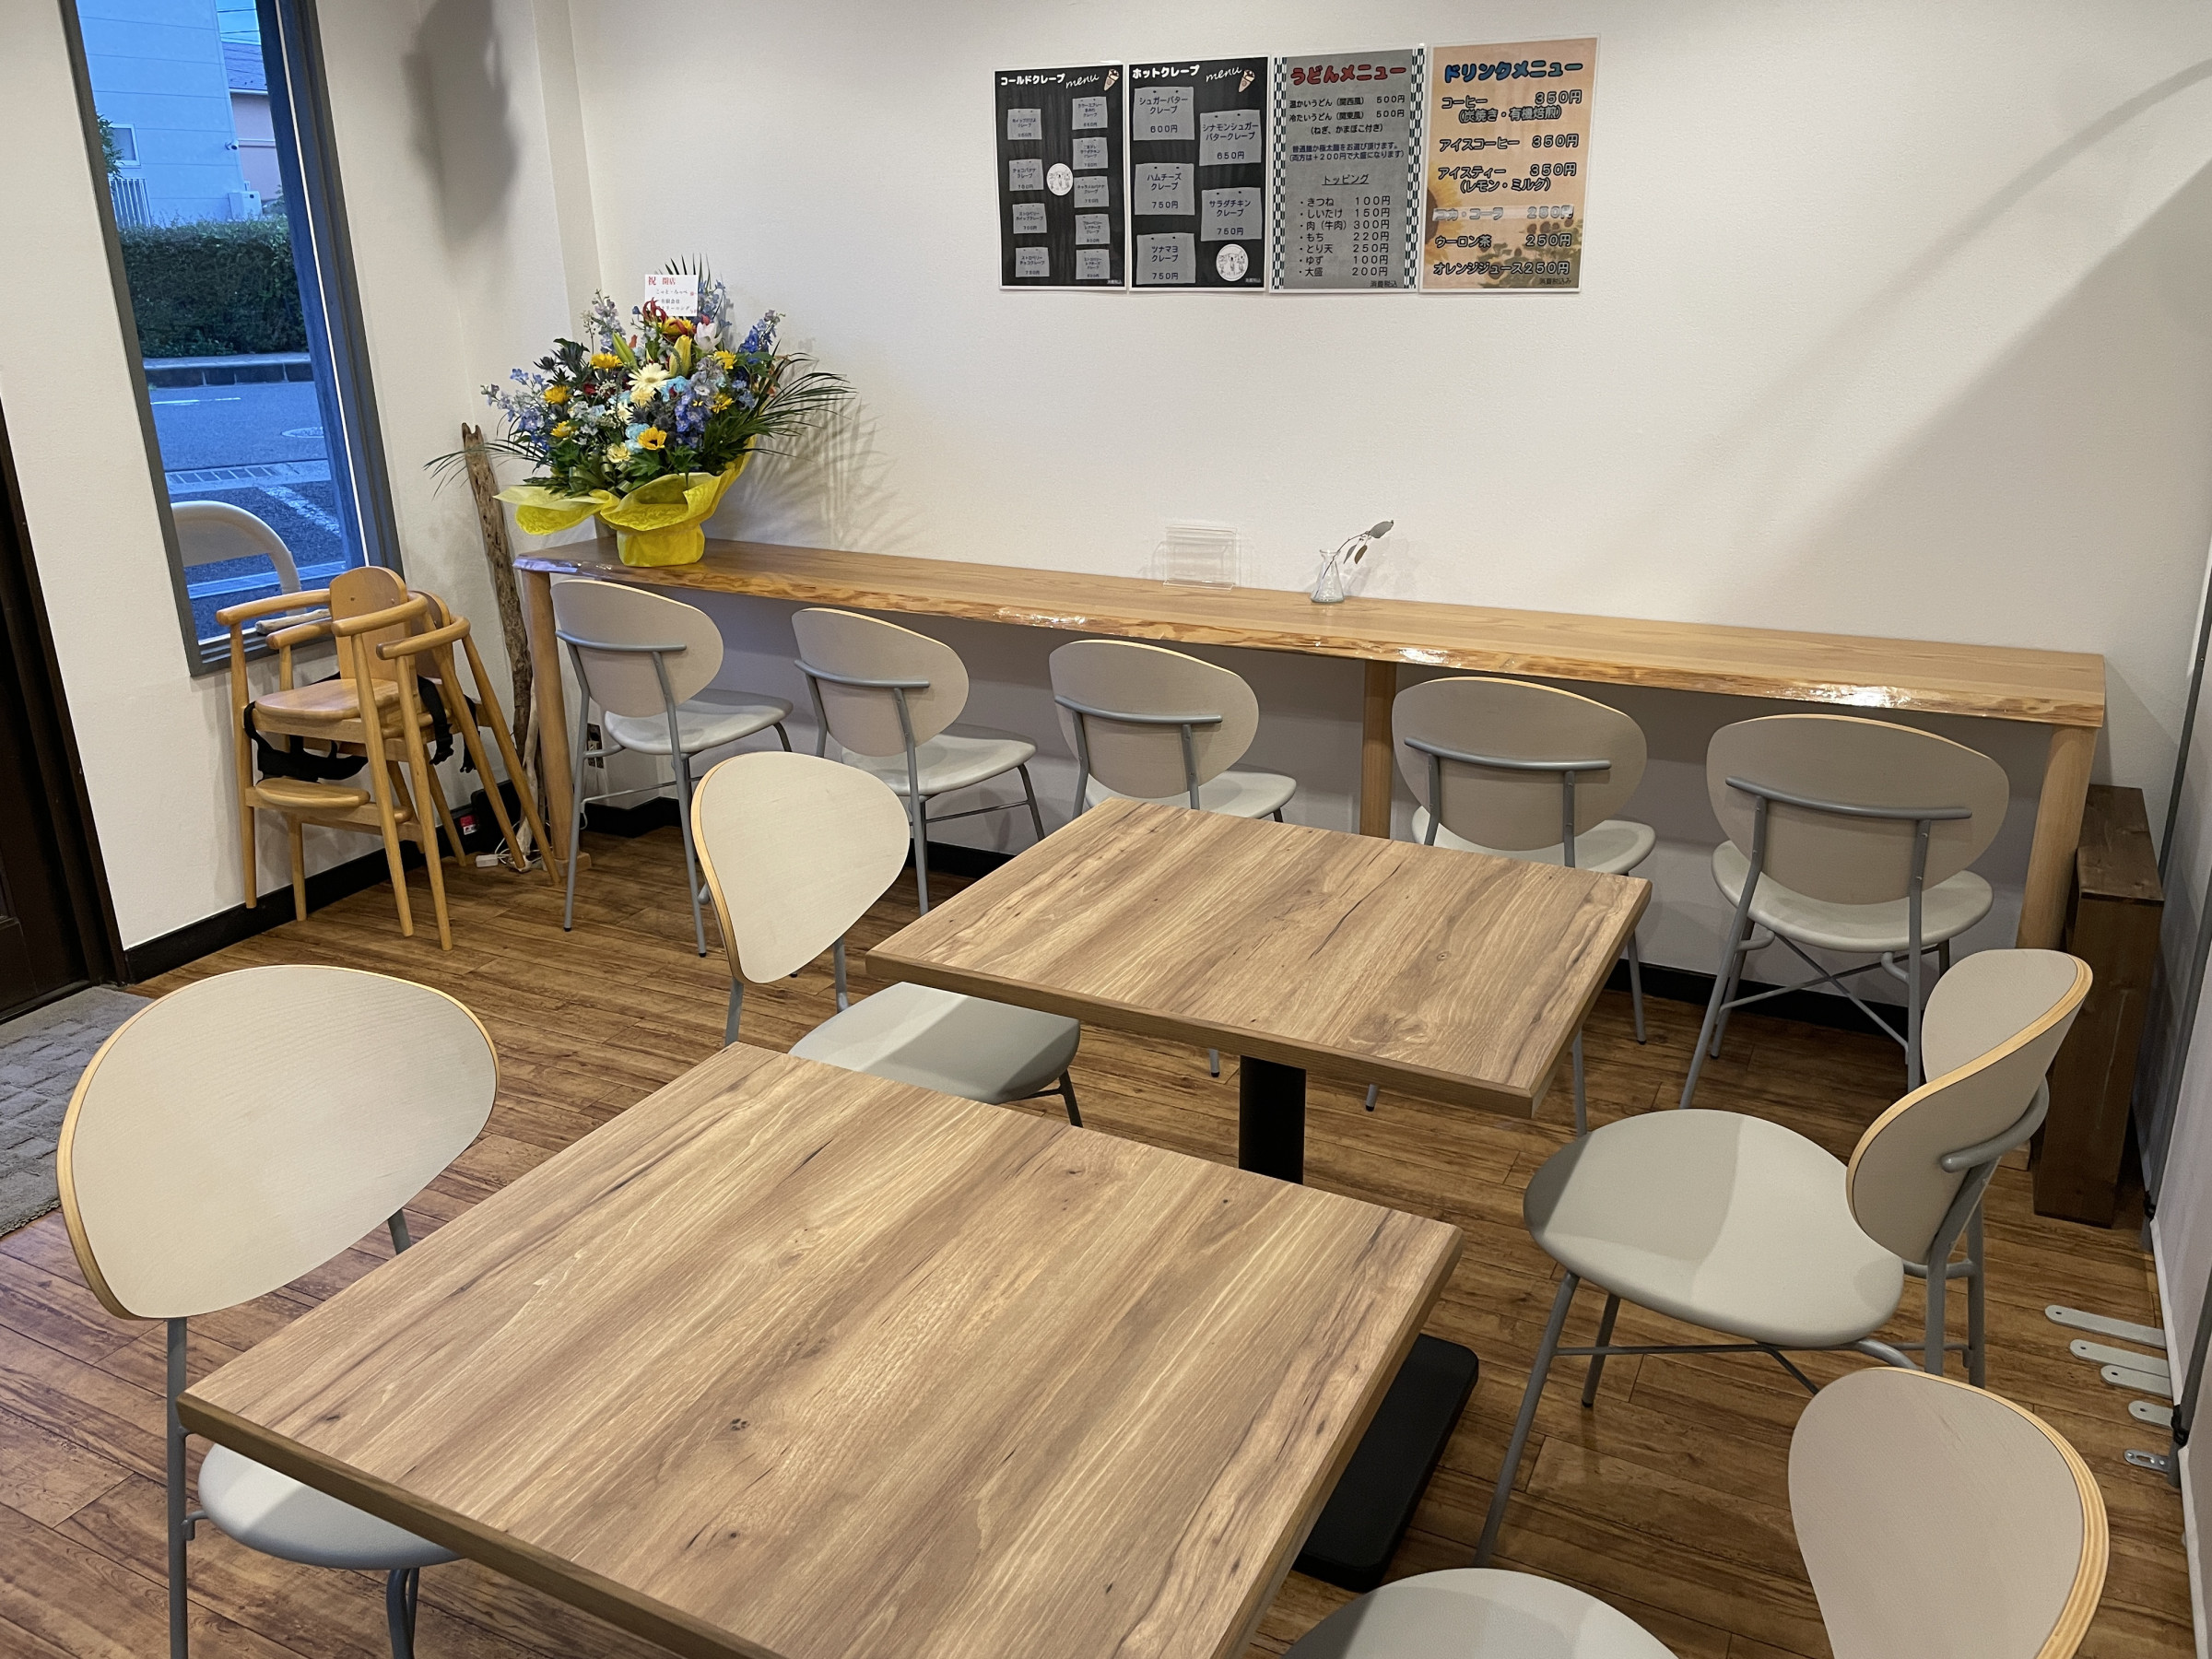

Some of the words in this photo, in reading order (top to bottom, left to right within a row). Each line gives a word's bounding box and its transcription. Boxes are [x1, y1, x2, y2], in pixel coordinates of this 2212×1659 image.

[1132, 65, 1200, 79] ホットクレープ
[1206, 66, 1242, 83] menu
[1290, 64, 1406, 86] うどんメニュー
[1444, 60, 1583, 83] ドリンクメニュー
[1000, 73, 1065, 86] コールドクレープ
[1065, 74, 1100, 89] menu
[1139, 96, 1188, 105] シュガーバター
[1376, 94, 1406, 104] 500円
[1441, 95, 1488, 109] コーヒー
[1535, 89, 1583, 104] 350円
[1149, 106, 1178, 114] クレープ
[1376, 109, 1405, 118] 500円
[1459, 105, 1562, 124] （炭焼き・有機焙煎）
[1150, 124, 1178, 133] 600円
[1203, 122, 1259, 132] シナモンシュガー
[1206, 132, 1255, 141] バタークレープ
[1440, 136, 1520, 152] アイスコーヒー
[1532, 134, 1579, 148] 350円
[1217, 151, 1245, 159] 650円
[1438, 166, 1507, 180] アイスティー
[1530, 162, 1577, 177] 350円
[1147, 173, 1182, 182] ハムチーズ
[1324, 173, 1370, 184] トッピング
[1150, 182, 1179, 191] クレープ
[1460, 177, 1550, 194] （レモン・ミルク）
[1151, 200, 1179, 209] 750円
[1209, 199, 1252, 207] サラダチキン
[1355, 195, 1391, 206] 100円
[1217, 208, 1244, 217] クレープ
[1355, 207, 1390, 218] 150円
[1353, 219, 1390, 229] 300円
[1217, 227, 1244, 236] 750円
[1353, 231, 1389, 241] 220円
[1435, 234, 1492, 248] ウーロン茶
[1525, 233, 1571, 247] 250円
[1151, 245, 1179, 253] ツナマヨ
[1353, 242, 1389, 253] 250円
[1151, 254, 1179, 263] クレープ
[1354, 254, 1388, 265] 100円
[1152, 272, 1179, 280] 750円
[1352, 266, 1388, 276] 200円
